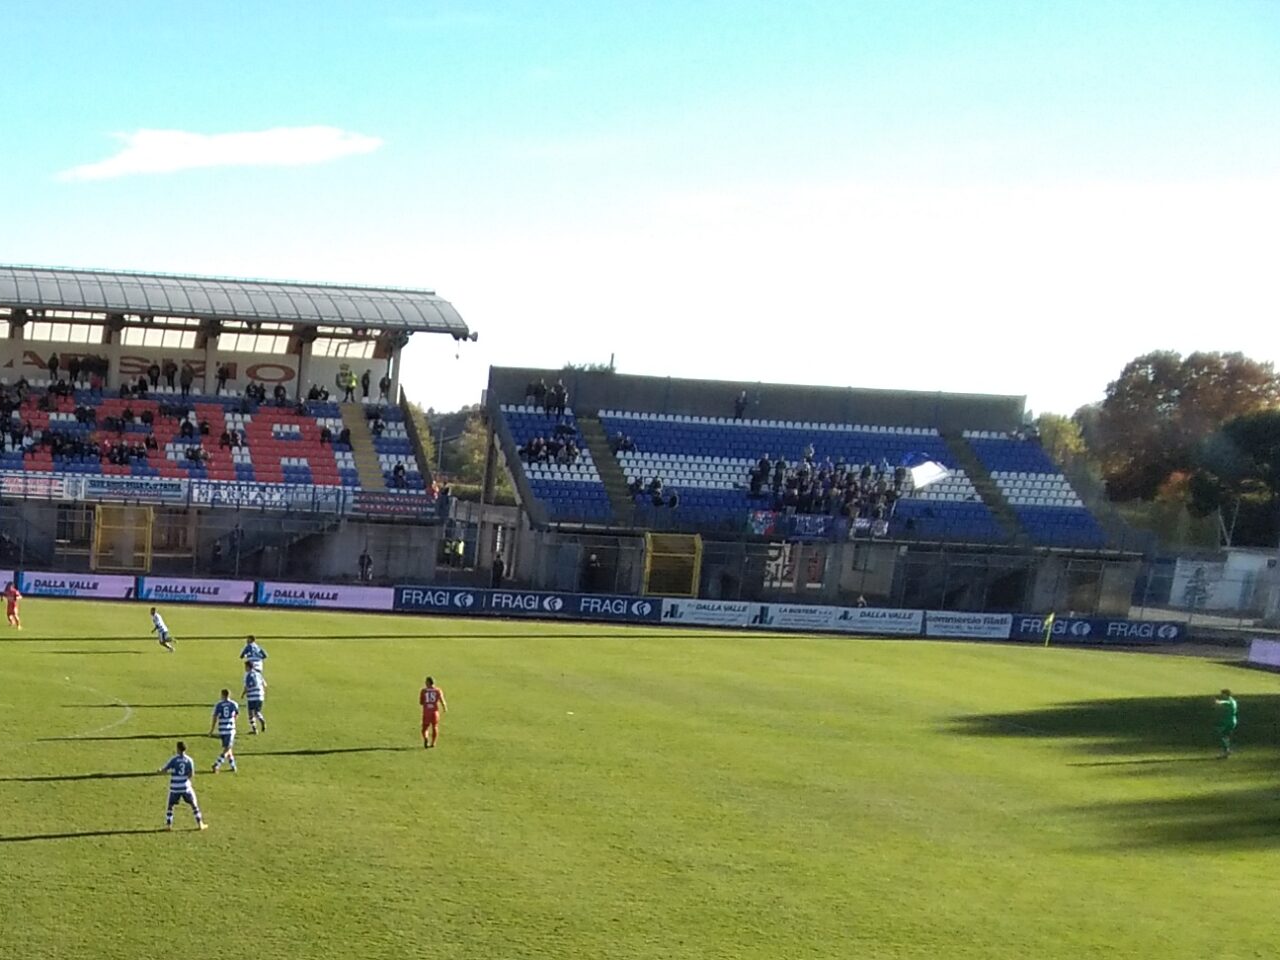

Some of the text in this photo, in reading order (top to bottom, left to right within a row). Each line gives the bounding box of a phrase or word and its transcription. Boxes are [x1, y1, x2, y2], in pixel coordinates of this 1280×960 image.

[33, 578, 99, 590] DALLA VALLE
[154, 584, 220, 596] DALLA VALLE
[273, 589, 339, 601] DALLA VALLE
[401, 589, 450, 605] FRAGI
[491, 592, 539, 610] FRAGI
[579, 598, 627, 614] FRAGI
[1020, 618, 1067, 635] FRAGI
[1107, 621, 1154, 637] FRAGI
